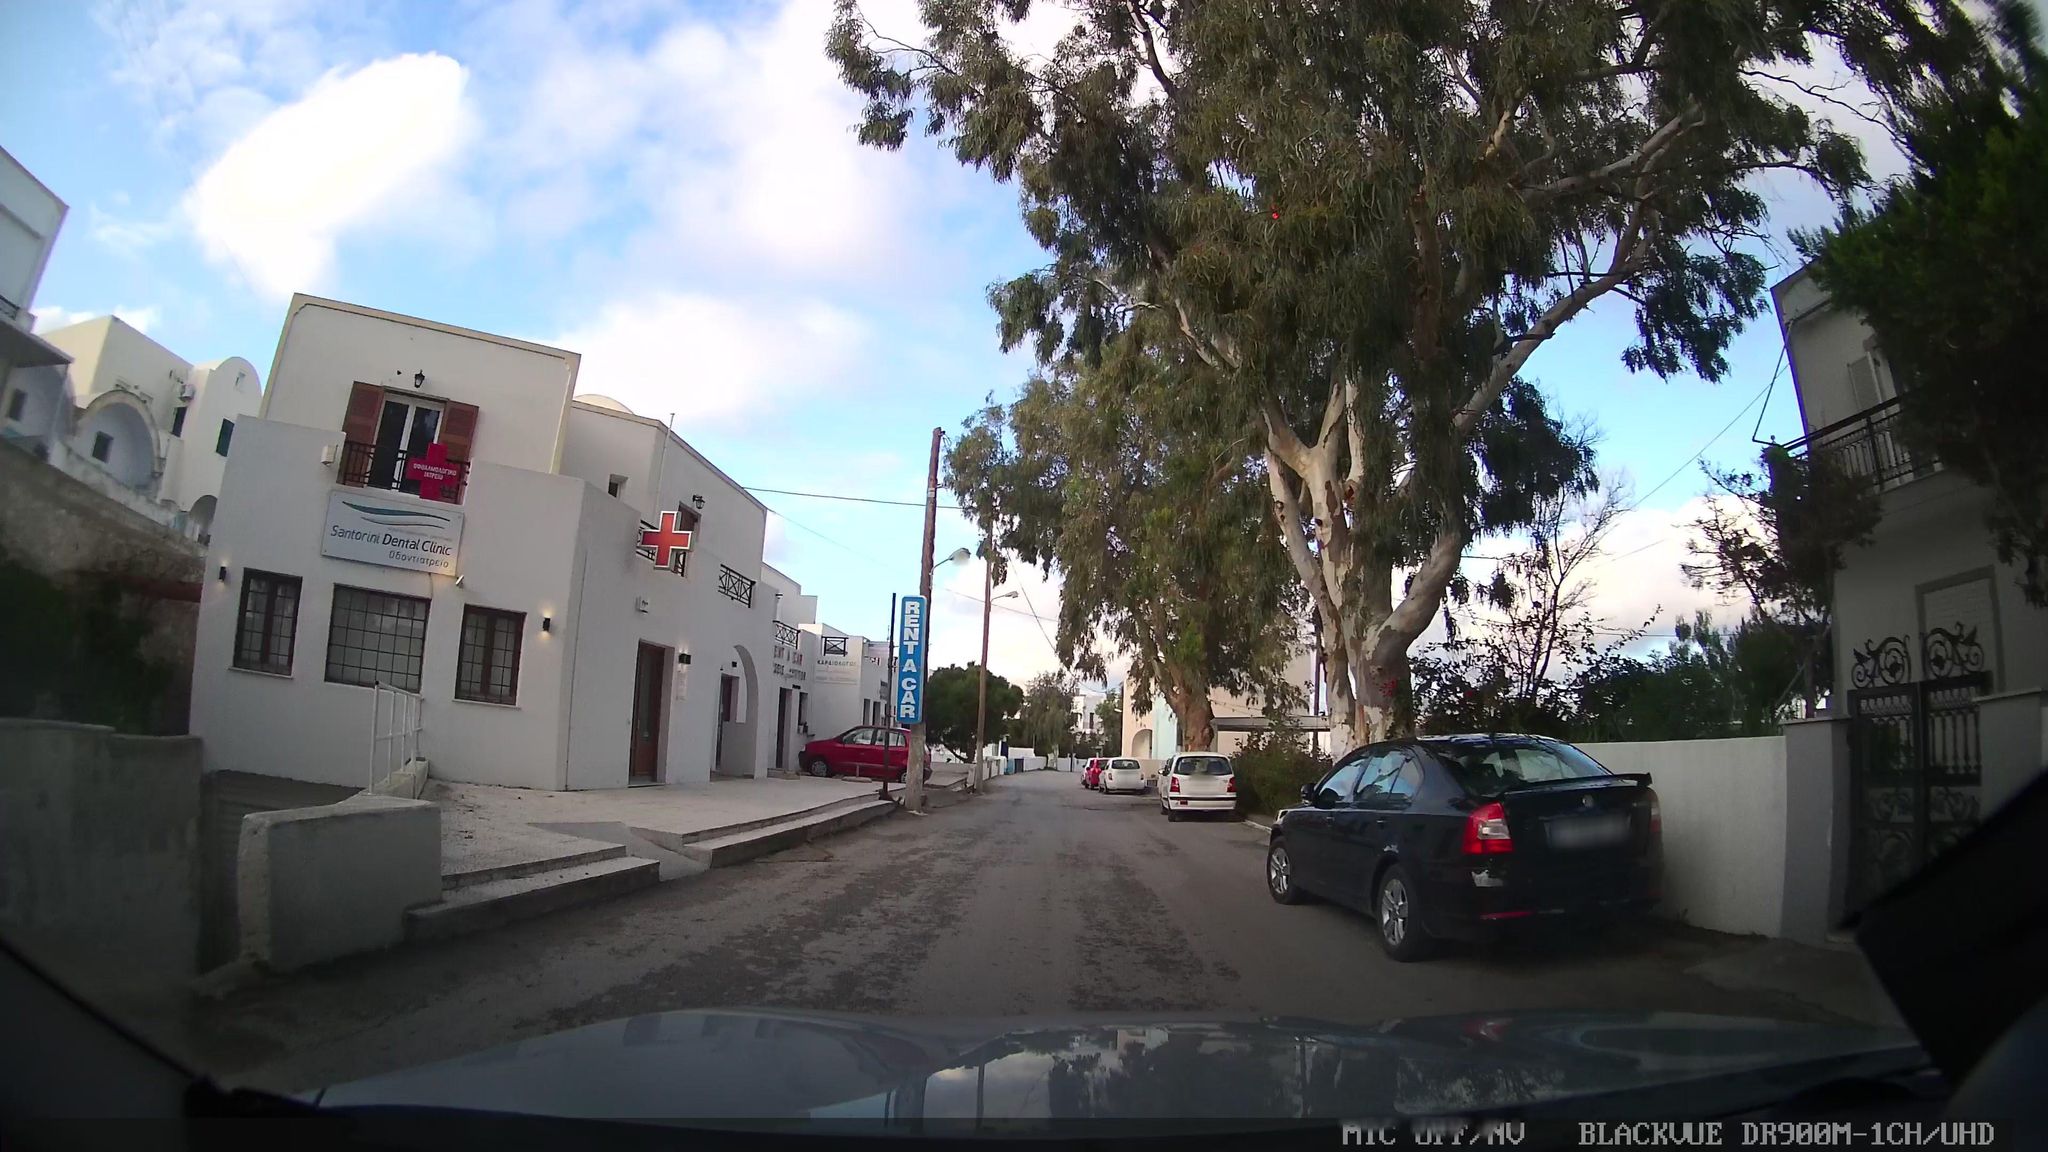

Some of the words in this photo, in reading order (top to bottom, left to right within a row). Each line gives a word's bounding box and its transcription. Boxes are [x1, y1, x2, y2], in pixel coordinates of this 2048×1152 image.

[330, 525, 380, 544] Santorini
[382, 533, 420, 550] Dental
[421, 540, 453, 556] Clinic
[903, 601, 920, 655] RENT
[902, 659, 917, 672] A
[900, 678, 917, 718] CAR
